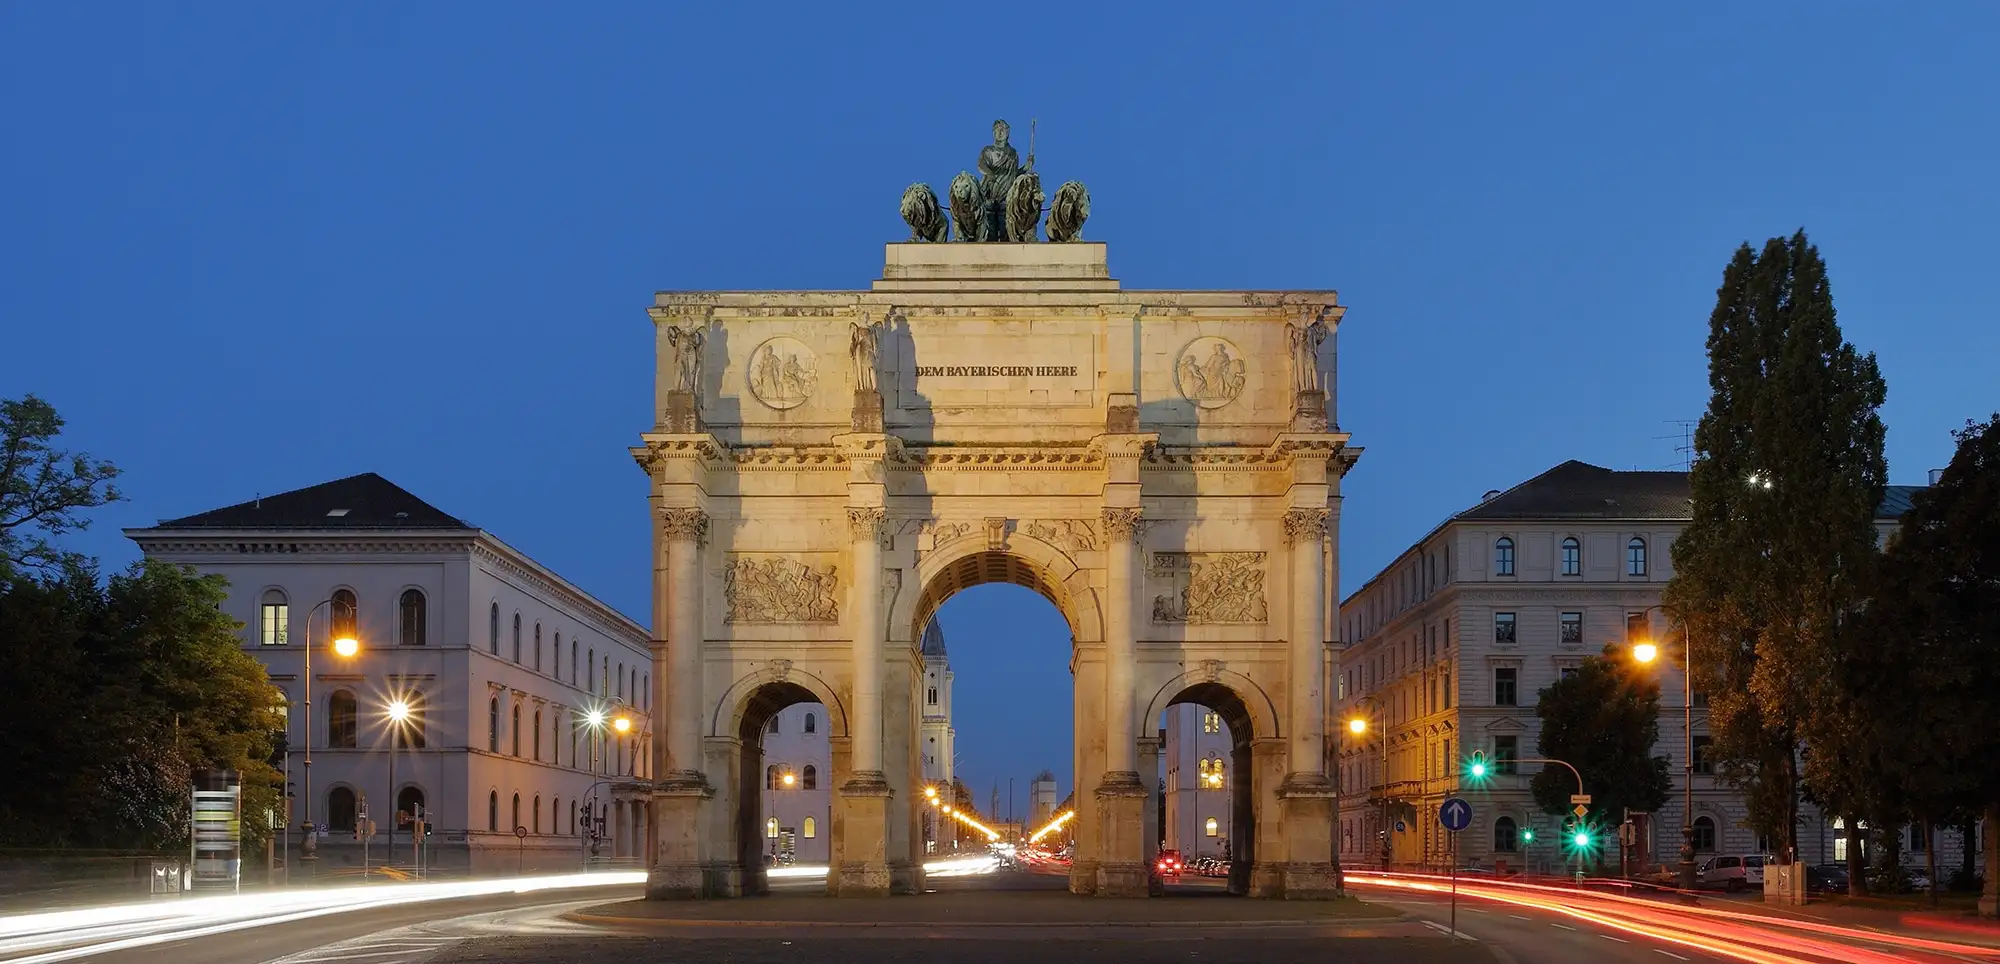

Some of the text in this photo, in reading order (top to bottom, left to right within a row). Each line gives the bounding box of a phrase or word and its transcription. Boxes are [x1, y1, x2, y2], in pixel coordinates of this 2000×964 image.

[915, 366, 1078, 377] DEM BAYERISCHEN HEERE
